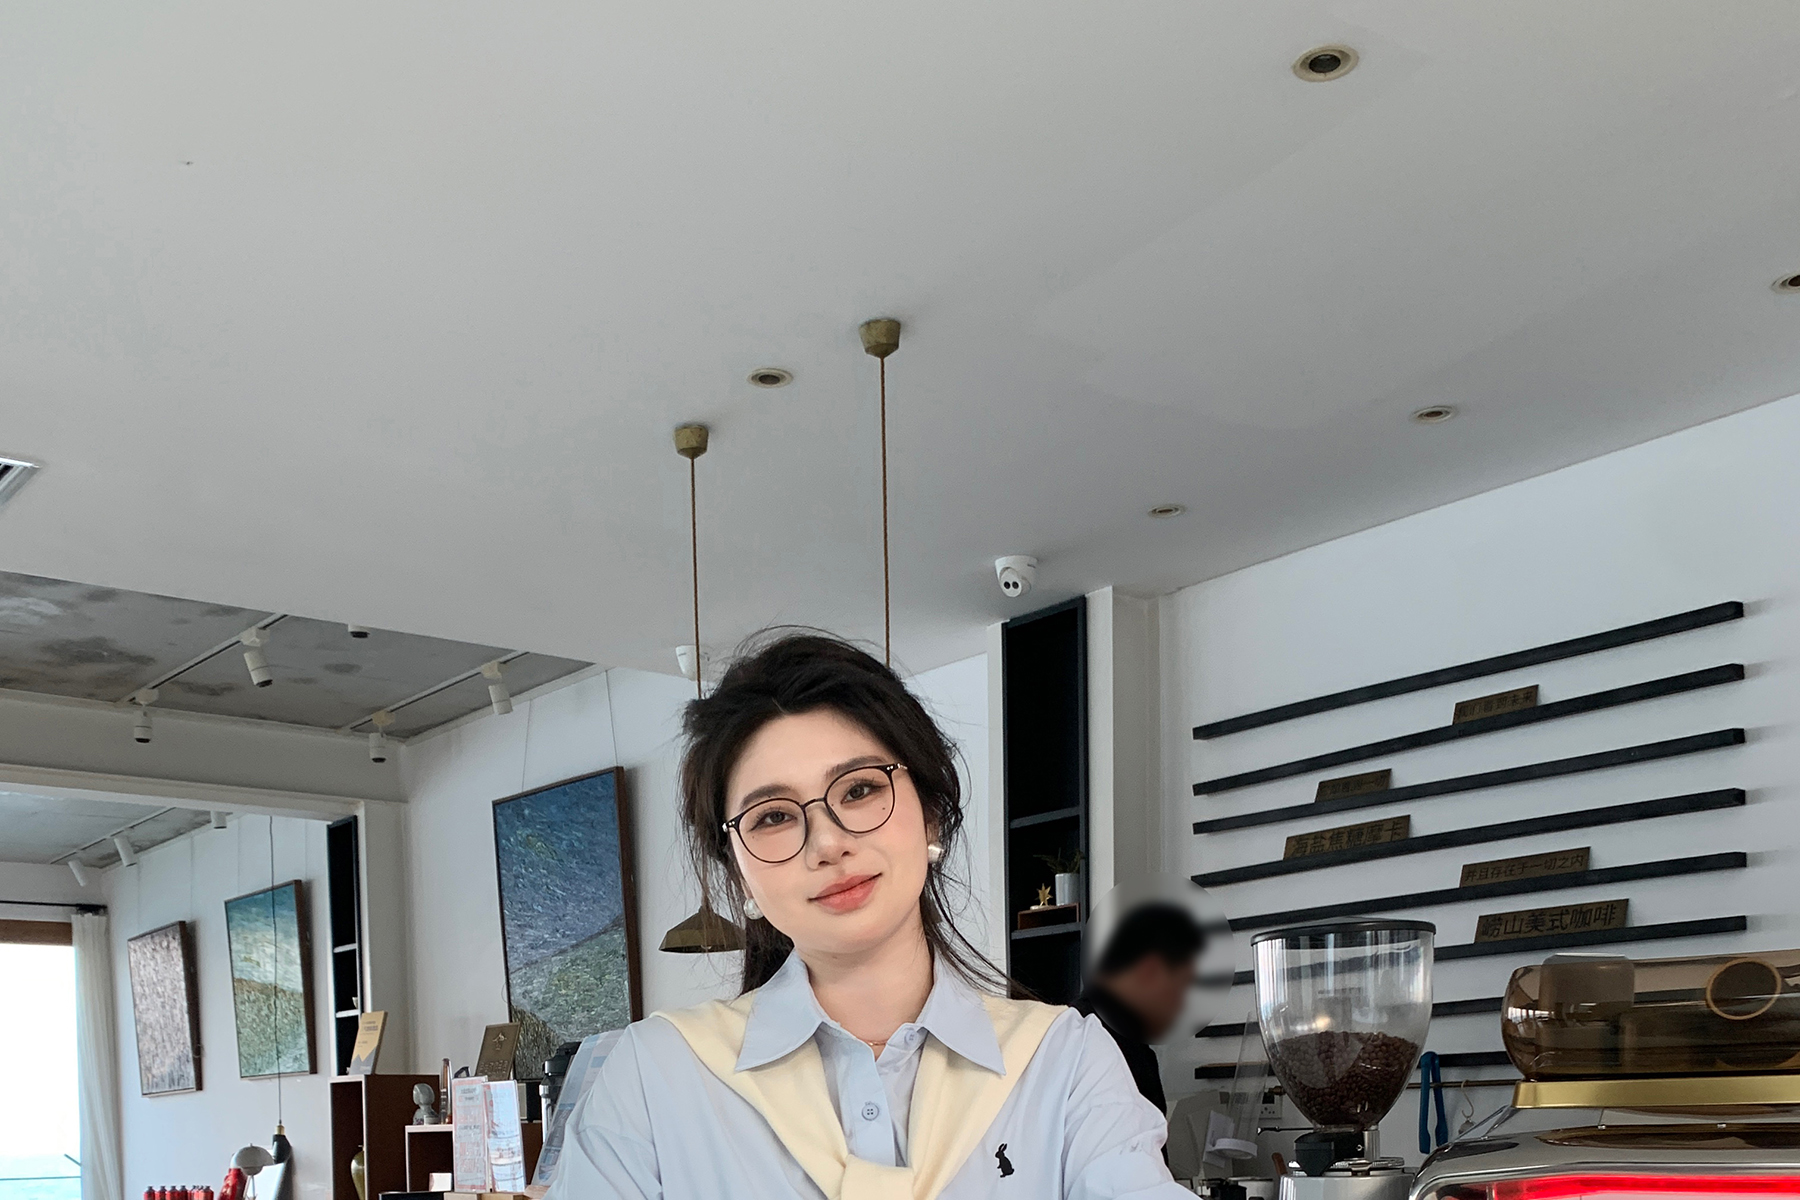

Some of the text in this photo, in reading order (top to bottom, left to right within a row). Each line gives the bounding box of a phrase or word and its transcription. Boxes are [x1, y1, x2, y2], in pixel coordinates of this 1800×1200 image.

[1464, 853, 1585, 882] 并且存在于一切之内
[1481, 904, 1616, 938] 崂山美式咖啡
